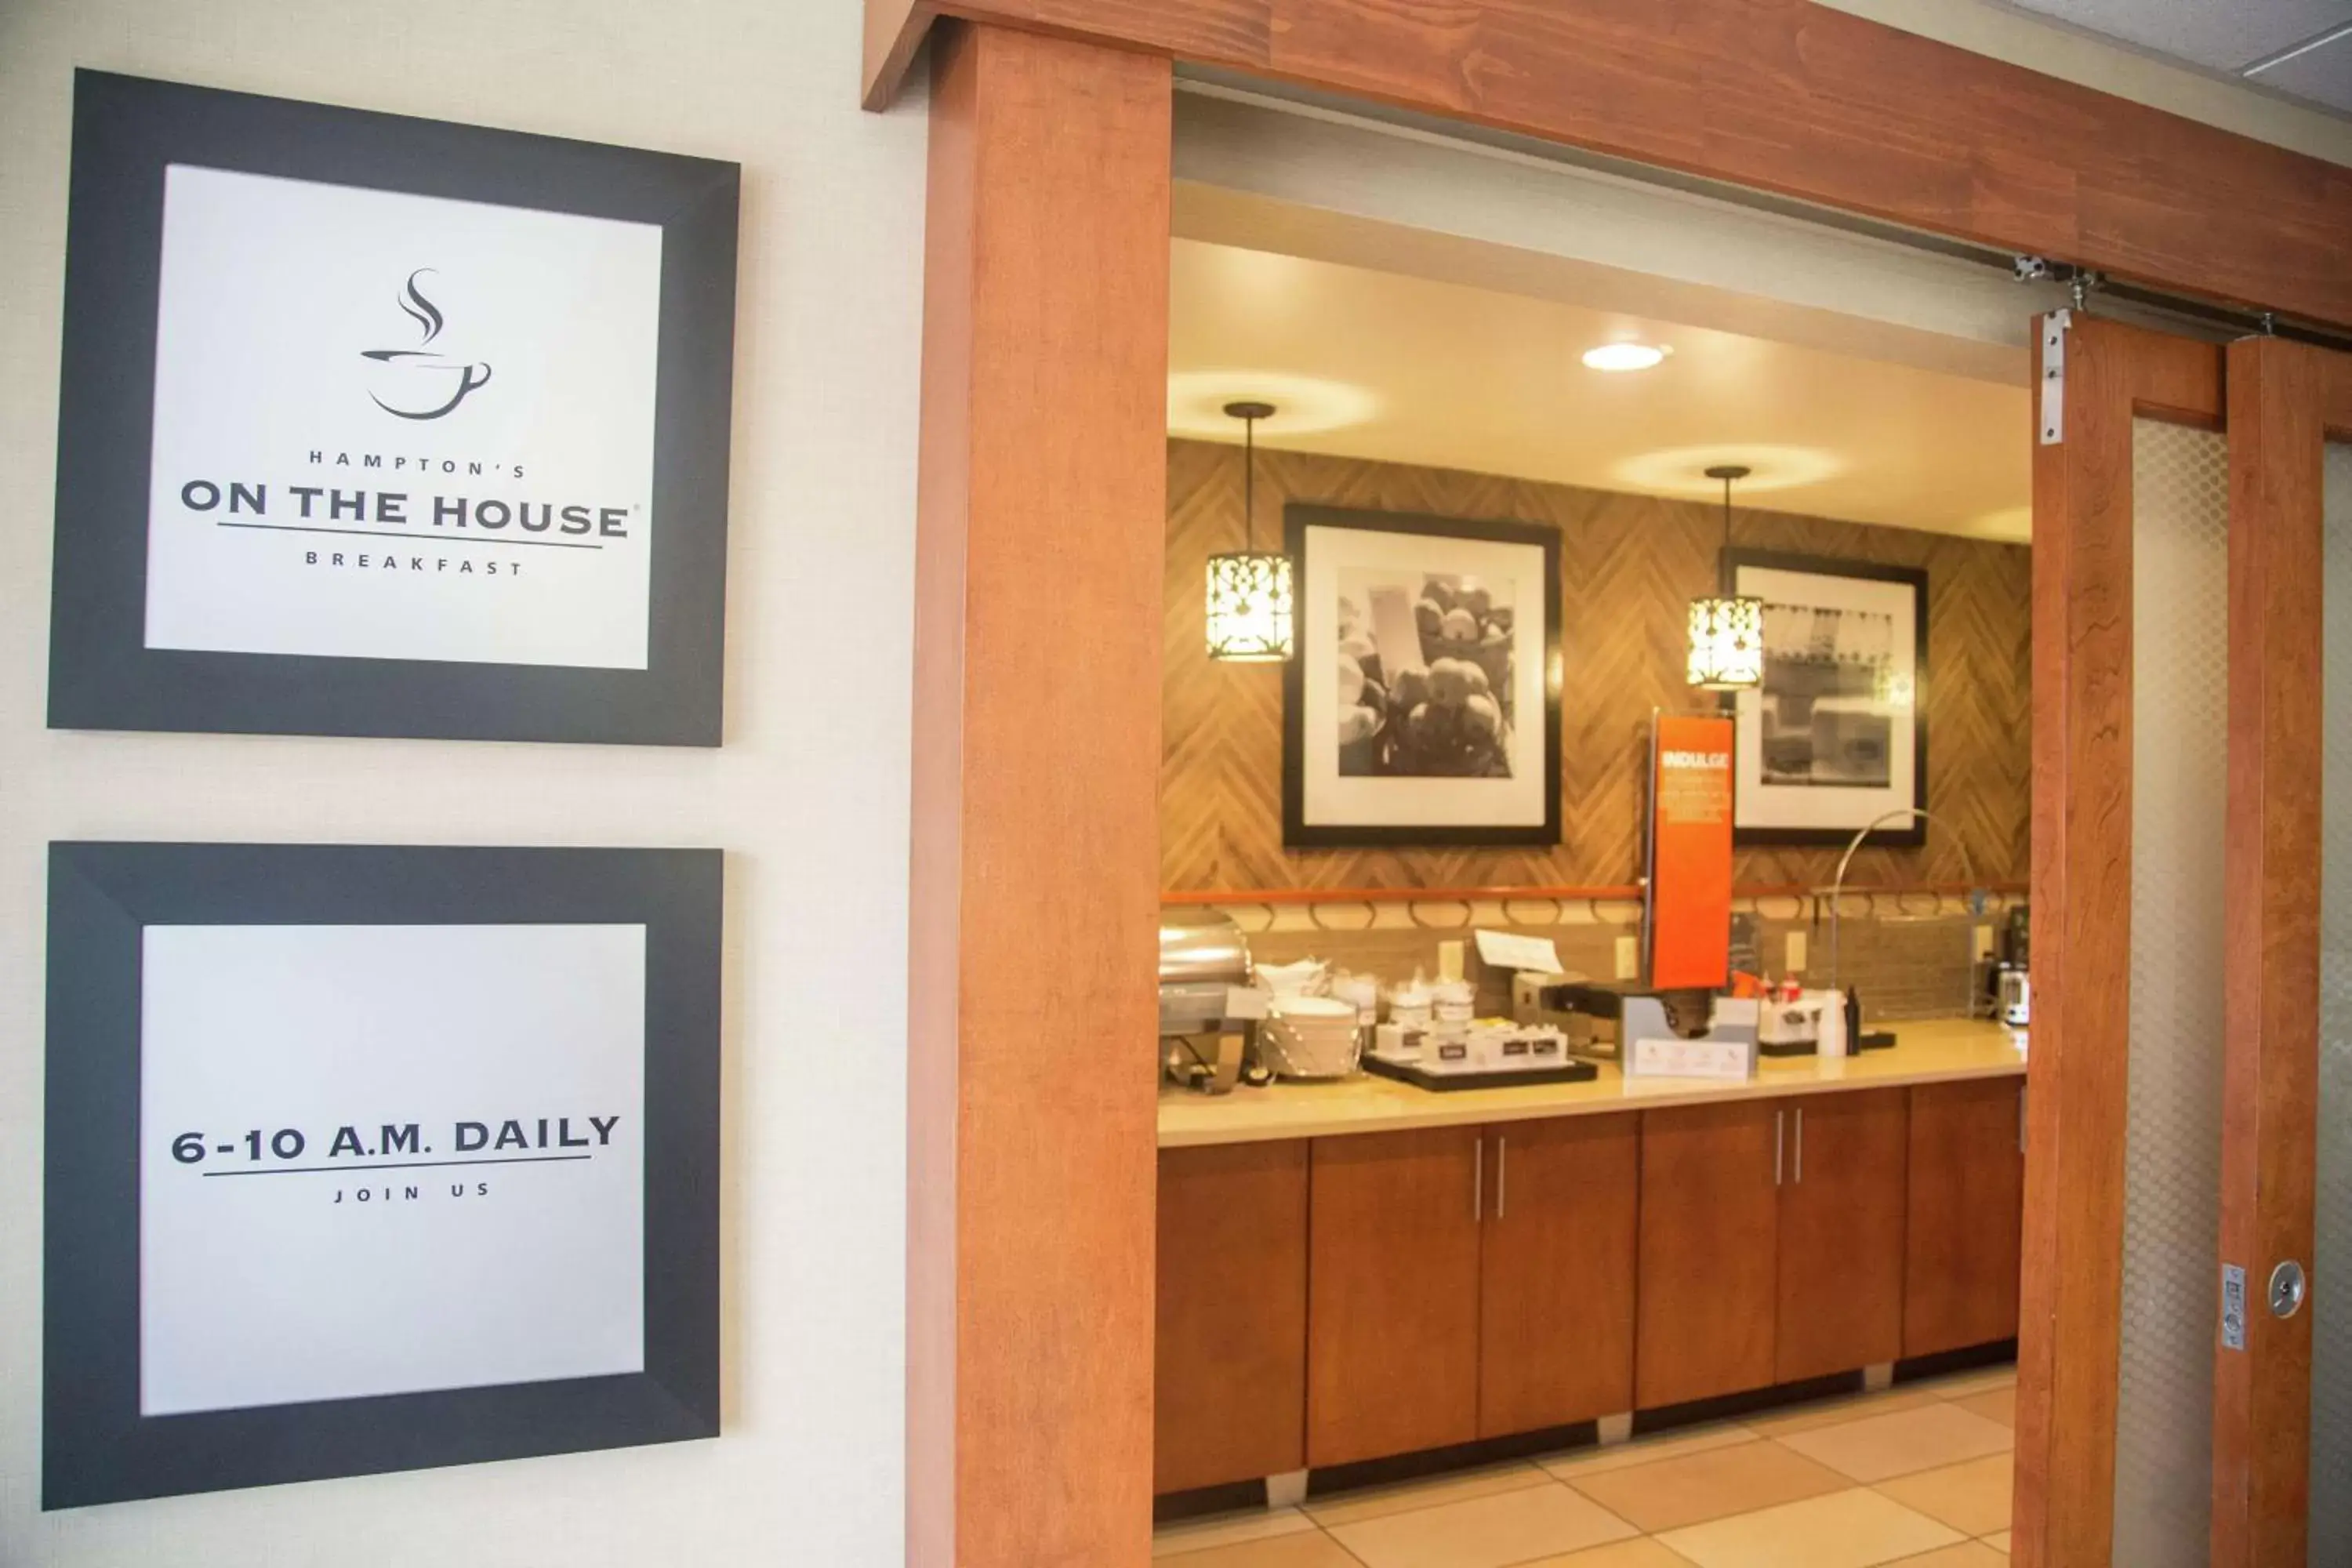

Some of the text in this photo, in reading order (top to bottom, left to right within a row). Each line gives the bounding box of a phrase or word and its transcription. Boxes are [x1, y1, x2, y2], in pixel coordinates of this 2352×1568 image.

[309, 450, 526, 479] HAMPTON'S
[180, 479, 267, 515] ON
[289, 485, 408, 524] THE
[305, 550, 524, 576] BREAKFAST
[1661, 750, 1730, 769] INDULGE
[171, 1115, 622, 1165] 6-10 A.M. DAILY
[334, 1181, 489, 1204] JOIN US
